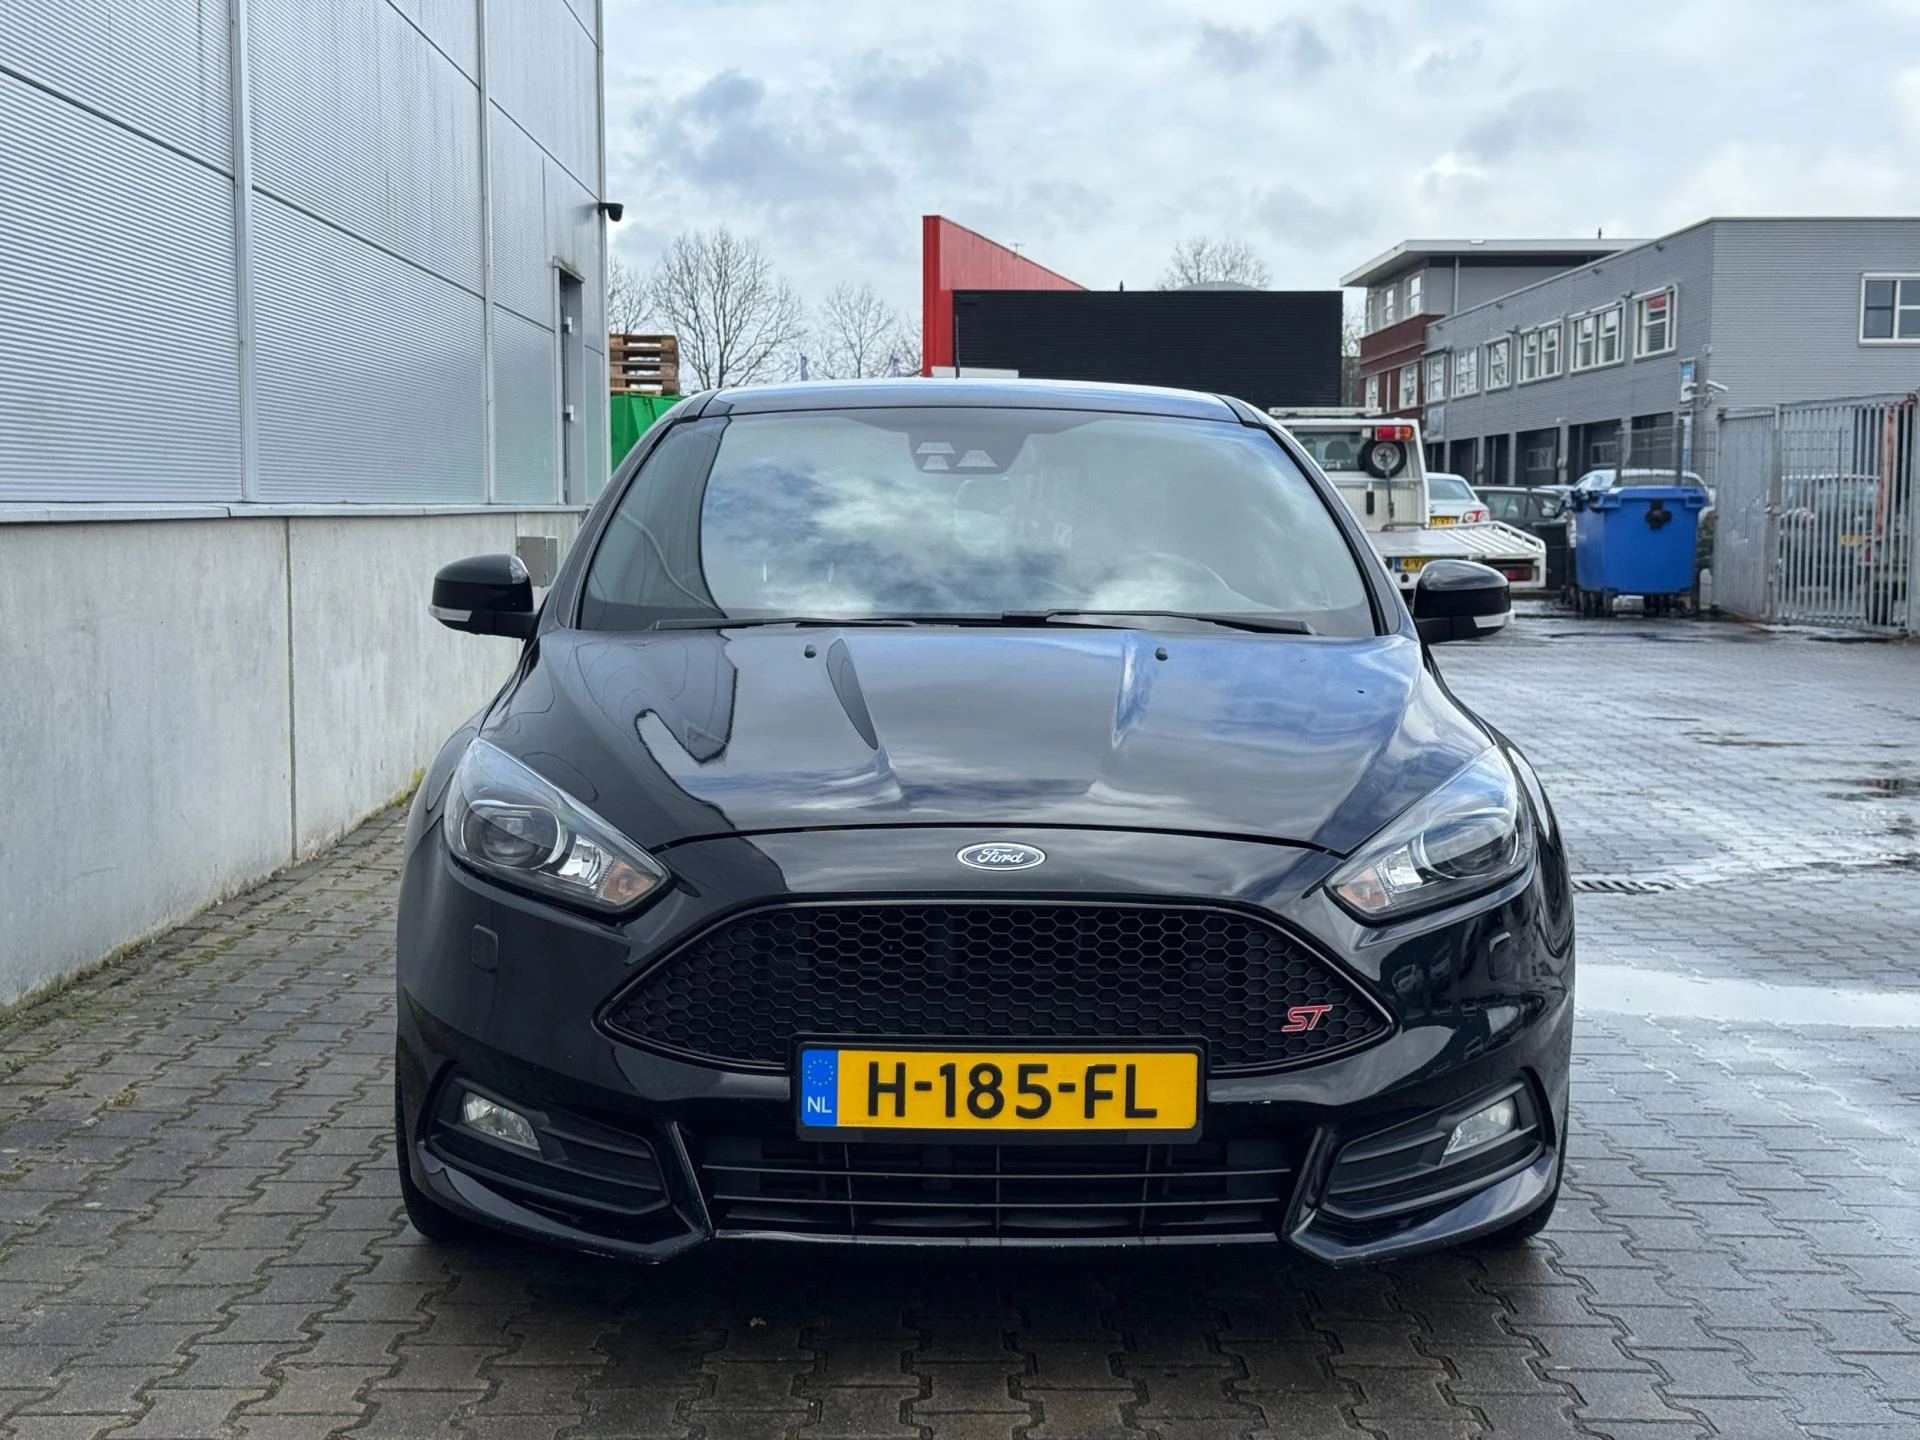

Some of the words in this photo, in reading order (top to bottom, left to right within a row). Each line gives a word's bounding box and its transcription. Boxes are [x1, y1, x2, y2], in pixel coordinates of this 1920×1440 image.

[976, 848, 1025, 863] Ford
[1281, 1004, 1333, 1032] ST
[868, 1061, 1158, 1119] H-185-FL
[807, 1096, 832, 1114] NL
